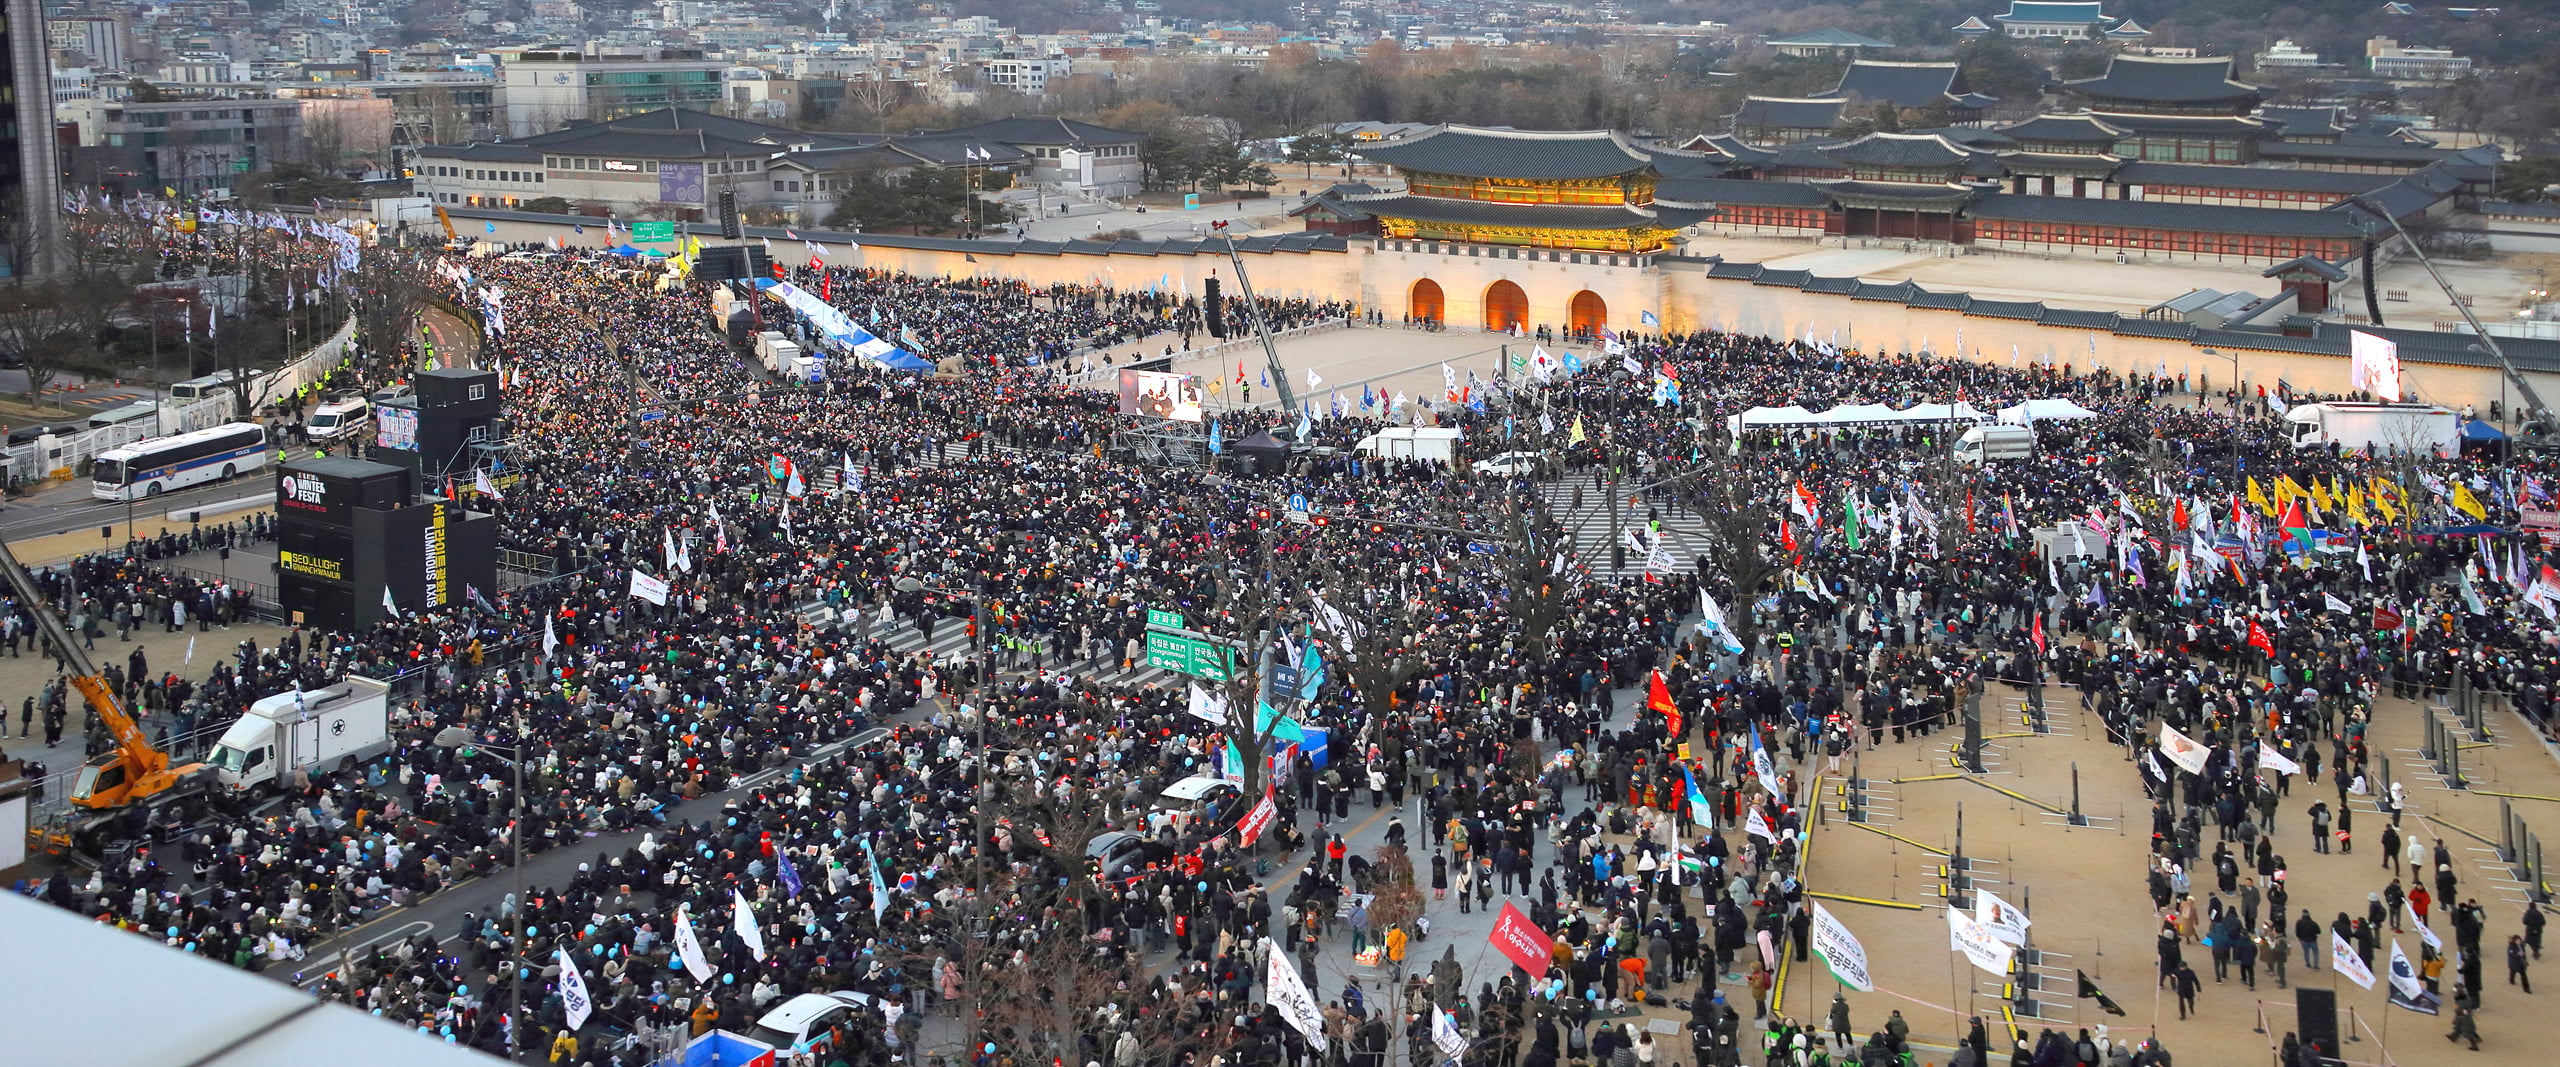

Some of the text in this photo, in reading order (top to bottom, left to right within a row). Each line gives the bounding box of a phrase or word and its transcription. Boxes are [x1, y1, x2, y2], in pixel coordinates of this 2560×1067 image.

[297, 479, 326, 494] WINTER
[298, 489, 321, 504] FESTA
[424, 526, 437, 608] LUMINOUS AXIS
[1153, 612, 1178, 626] 광화문
[1151, 637, 1169, 649] 독립문
[1509, 933, 1535, 958] 아수나로
